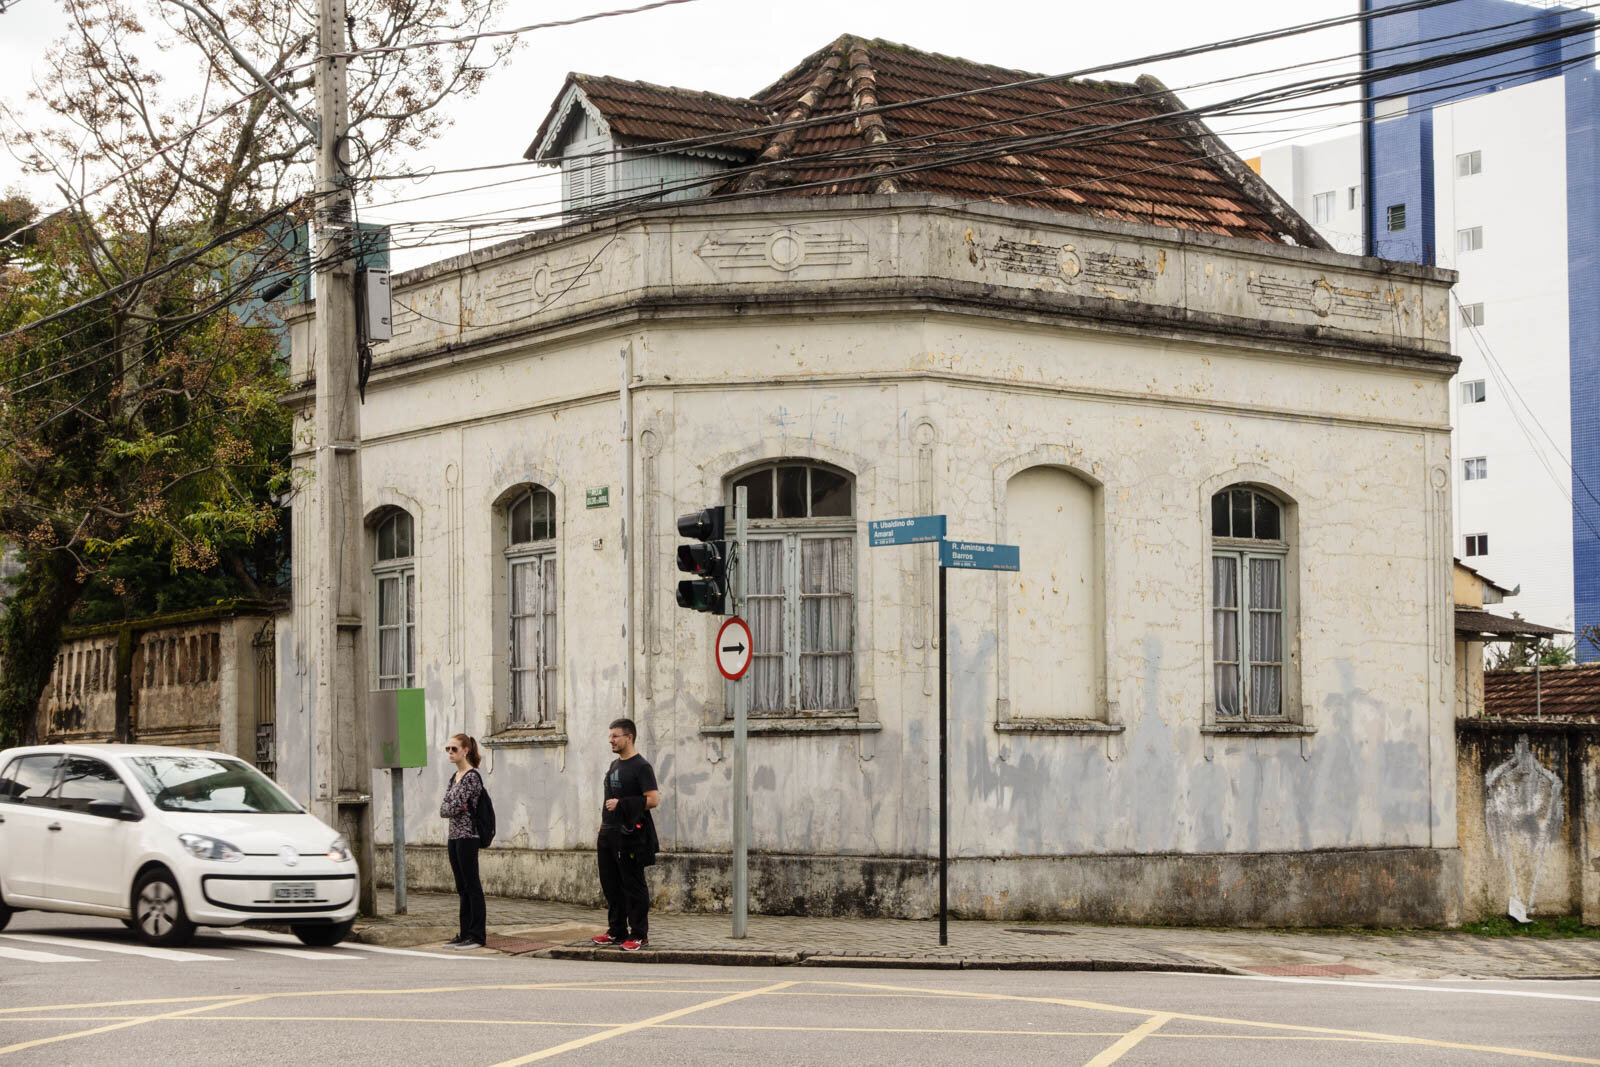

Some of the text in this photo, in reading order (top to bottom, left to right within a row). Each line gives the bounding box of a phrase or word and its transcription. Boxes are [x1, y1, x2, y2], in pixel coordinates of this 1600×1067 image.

[880, 520, 905, 529] Ubaldino
[960, 543, 985, 552] Amintas
[952, 552, 973, 560] Barros
